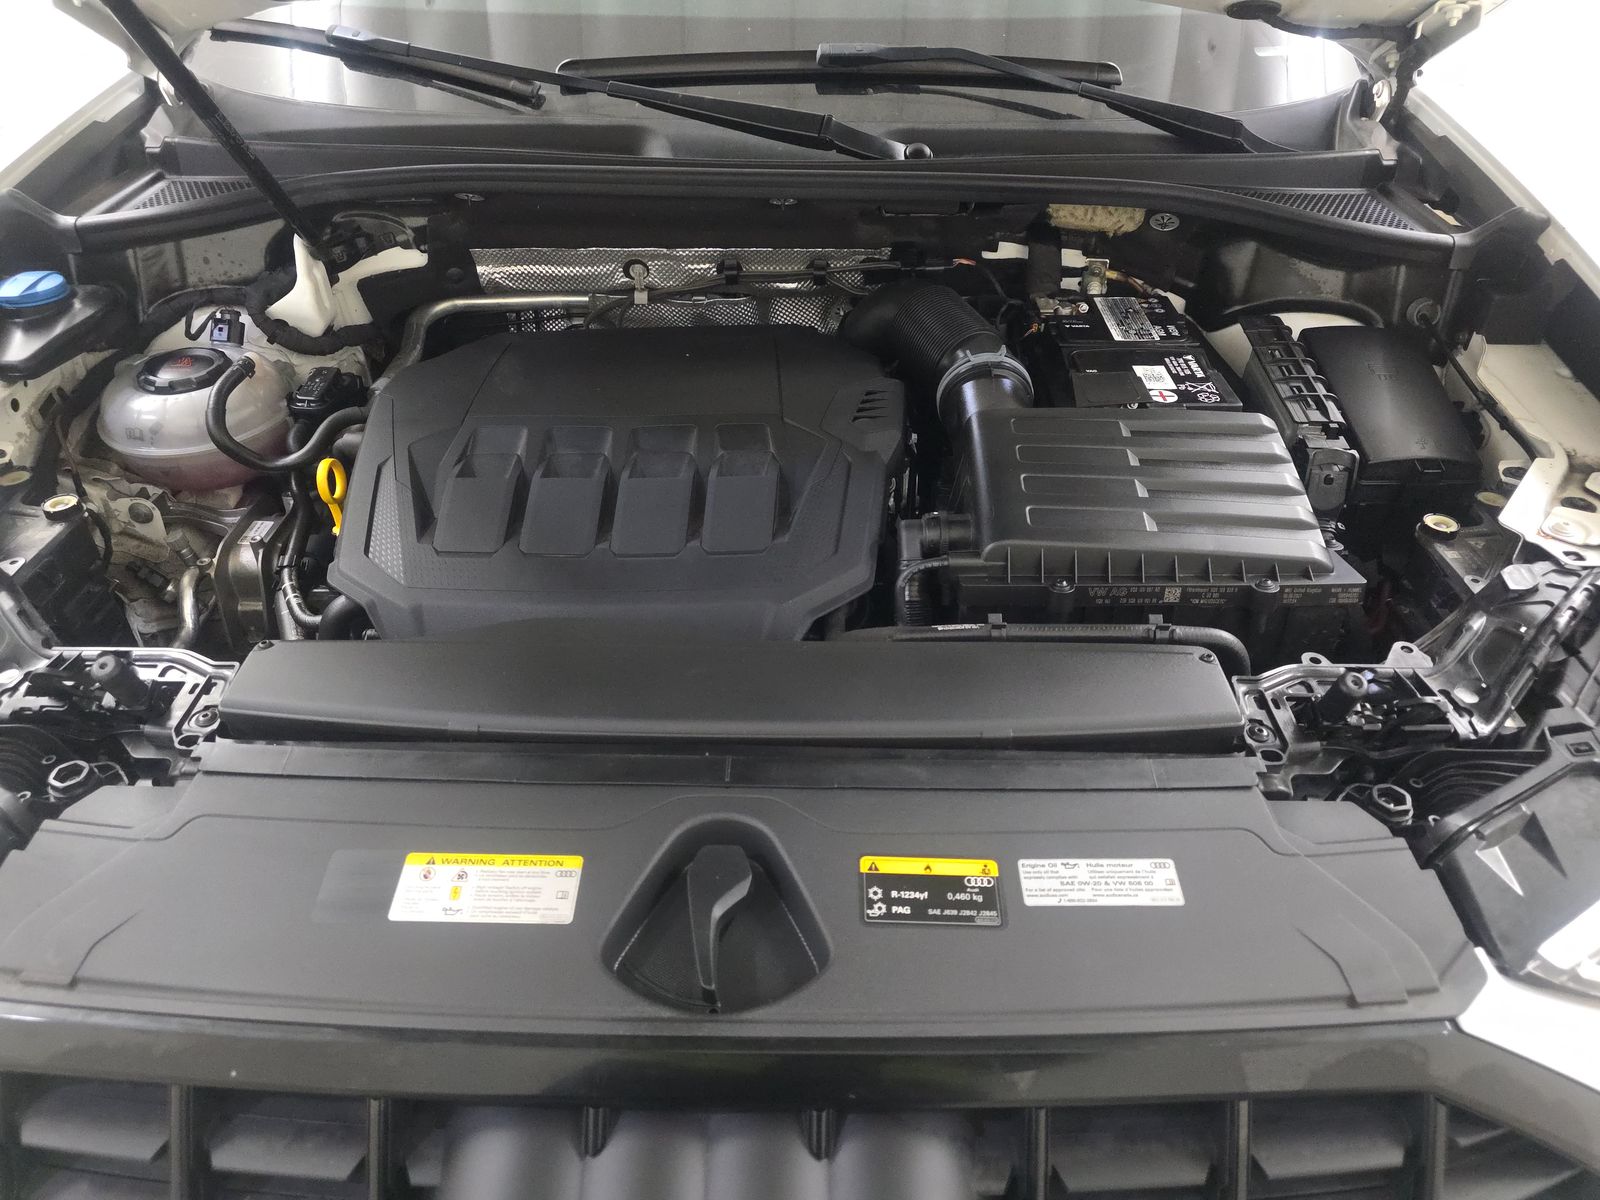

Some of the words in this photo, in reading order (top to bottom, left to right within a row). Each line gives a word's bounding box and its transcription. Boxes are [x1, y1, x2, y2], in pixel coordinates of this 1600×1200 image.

[441, 857, 496, 866] WARNING
[502, 858, 565, 867] ATTENTION
[890, 889, 929, 901] R-1234yf
[972, 892, 983, 903] kg
[891, 905, 911, 915] PAG
